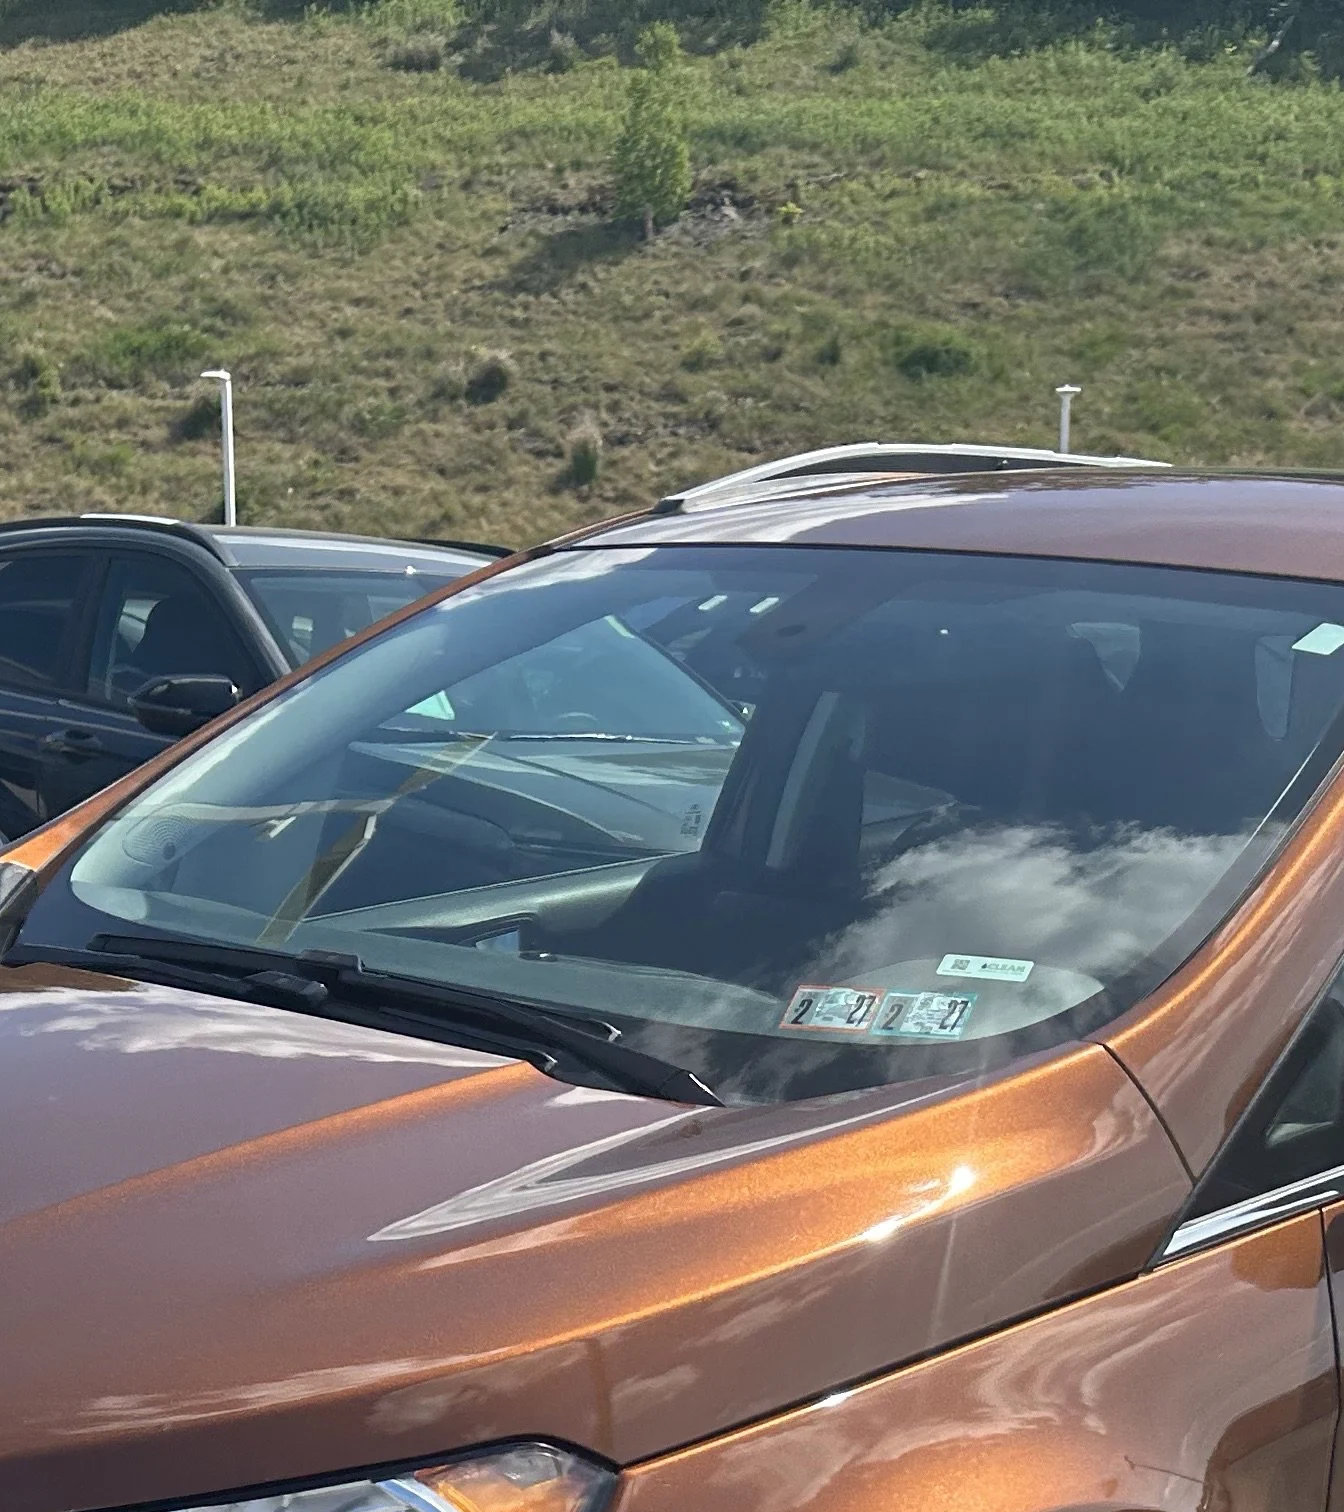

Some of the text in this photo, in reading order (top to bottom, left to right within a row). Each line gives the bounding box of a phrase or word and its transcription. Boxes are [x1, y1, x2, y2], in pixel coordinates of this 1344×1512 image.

[791, 995, 876, 1026] 2 27
[882, 999, 969, 1031] 2 27
